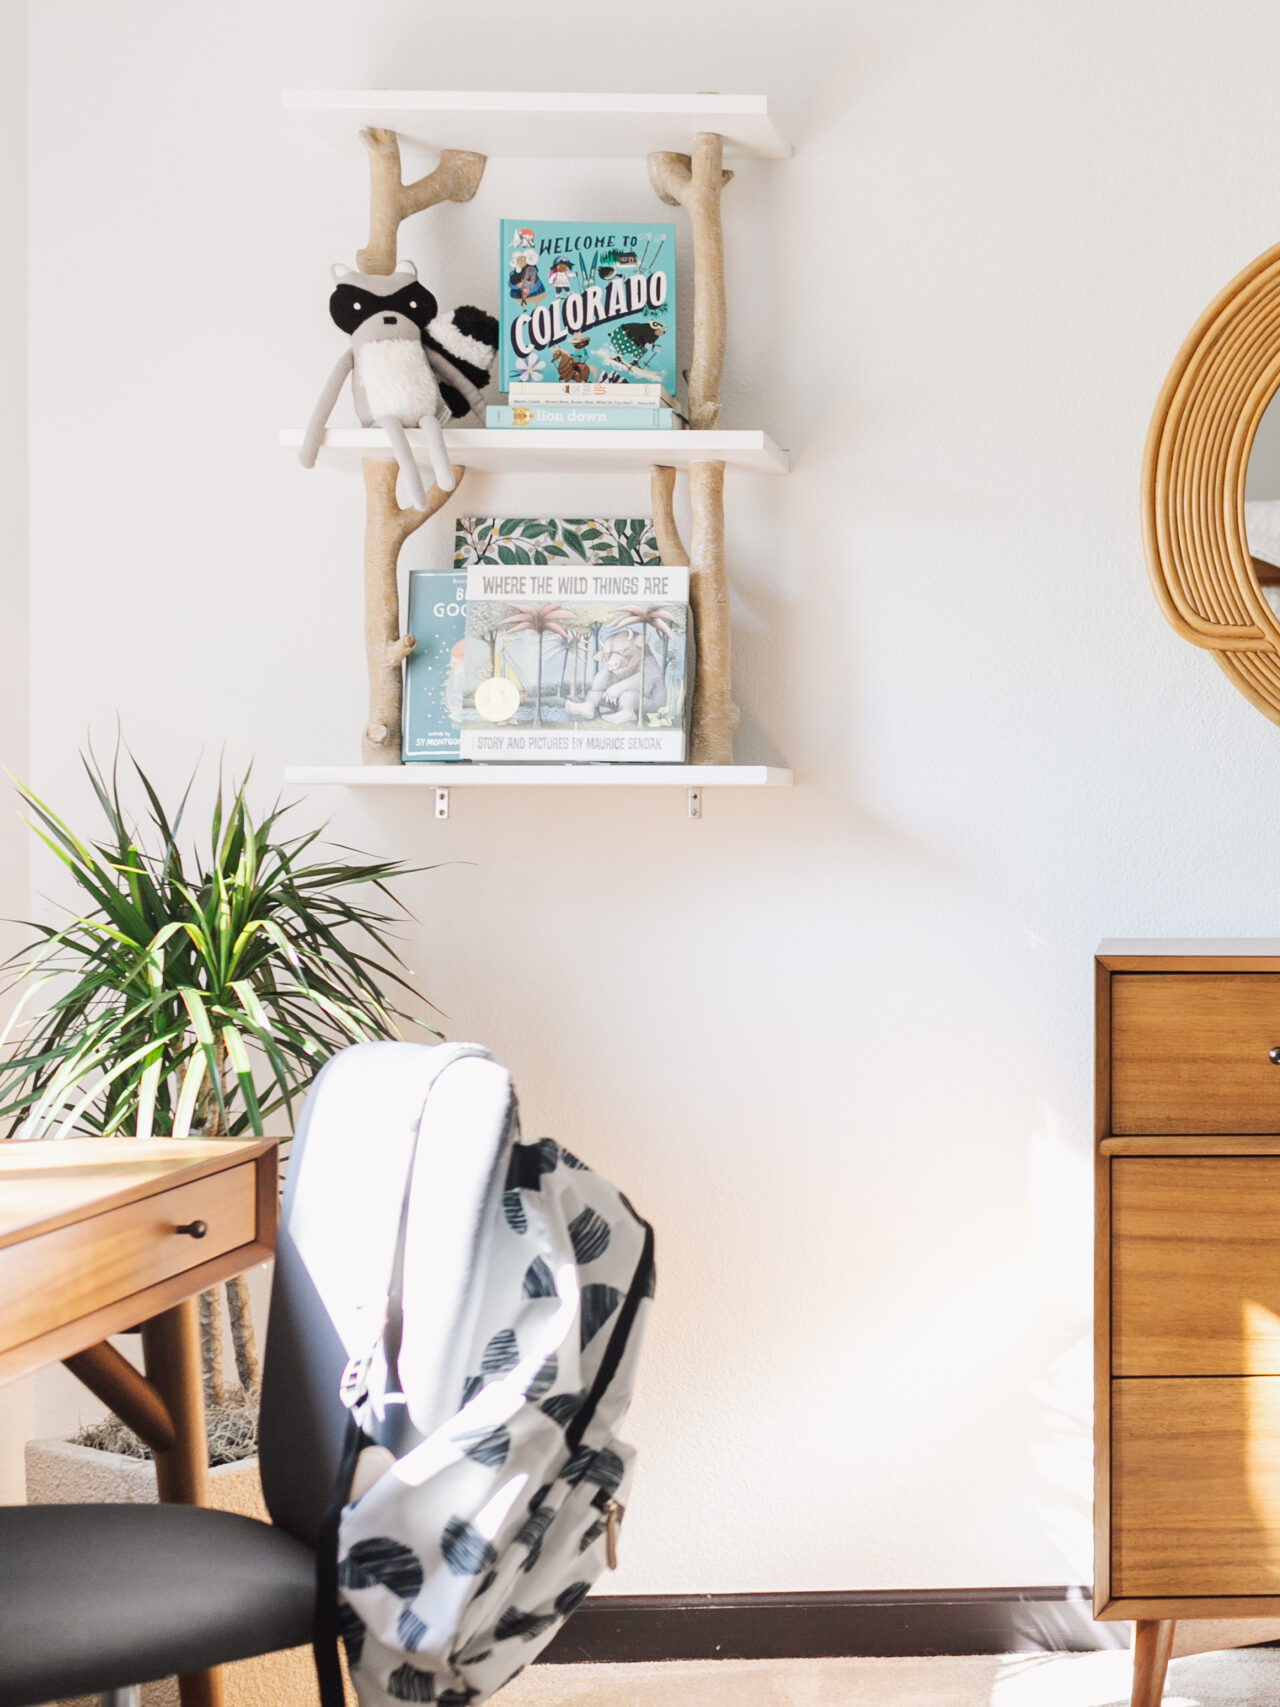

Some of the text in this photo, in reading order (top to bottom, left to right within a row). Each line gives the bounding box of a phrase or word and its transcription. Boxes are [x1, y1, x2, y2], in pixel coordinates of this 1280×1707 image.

[539, 235, 638, 256] WELCOME TO
[510, 270, 667, 358] COLORADO
[535, 409, 607, 423] lion down
[482, 576, 669, 595] WHERE THE WILD THINGS ARE
[415, 737, 460, 746] SY MONTGO
[477, 736, 504, 750] STORY
[506, 736, 525, 750] AND
[528, 736, 569, 750] PICTURES
[586, 736, 625, 750] MAURICE
[627, 736, 662, 750] SENDAK
